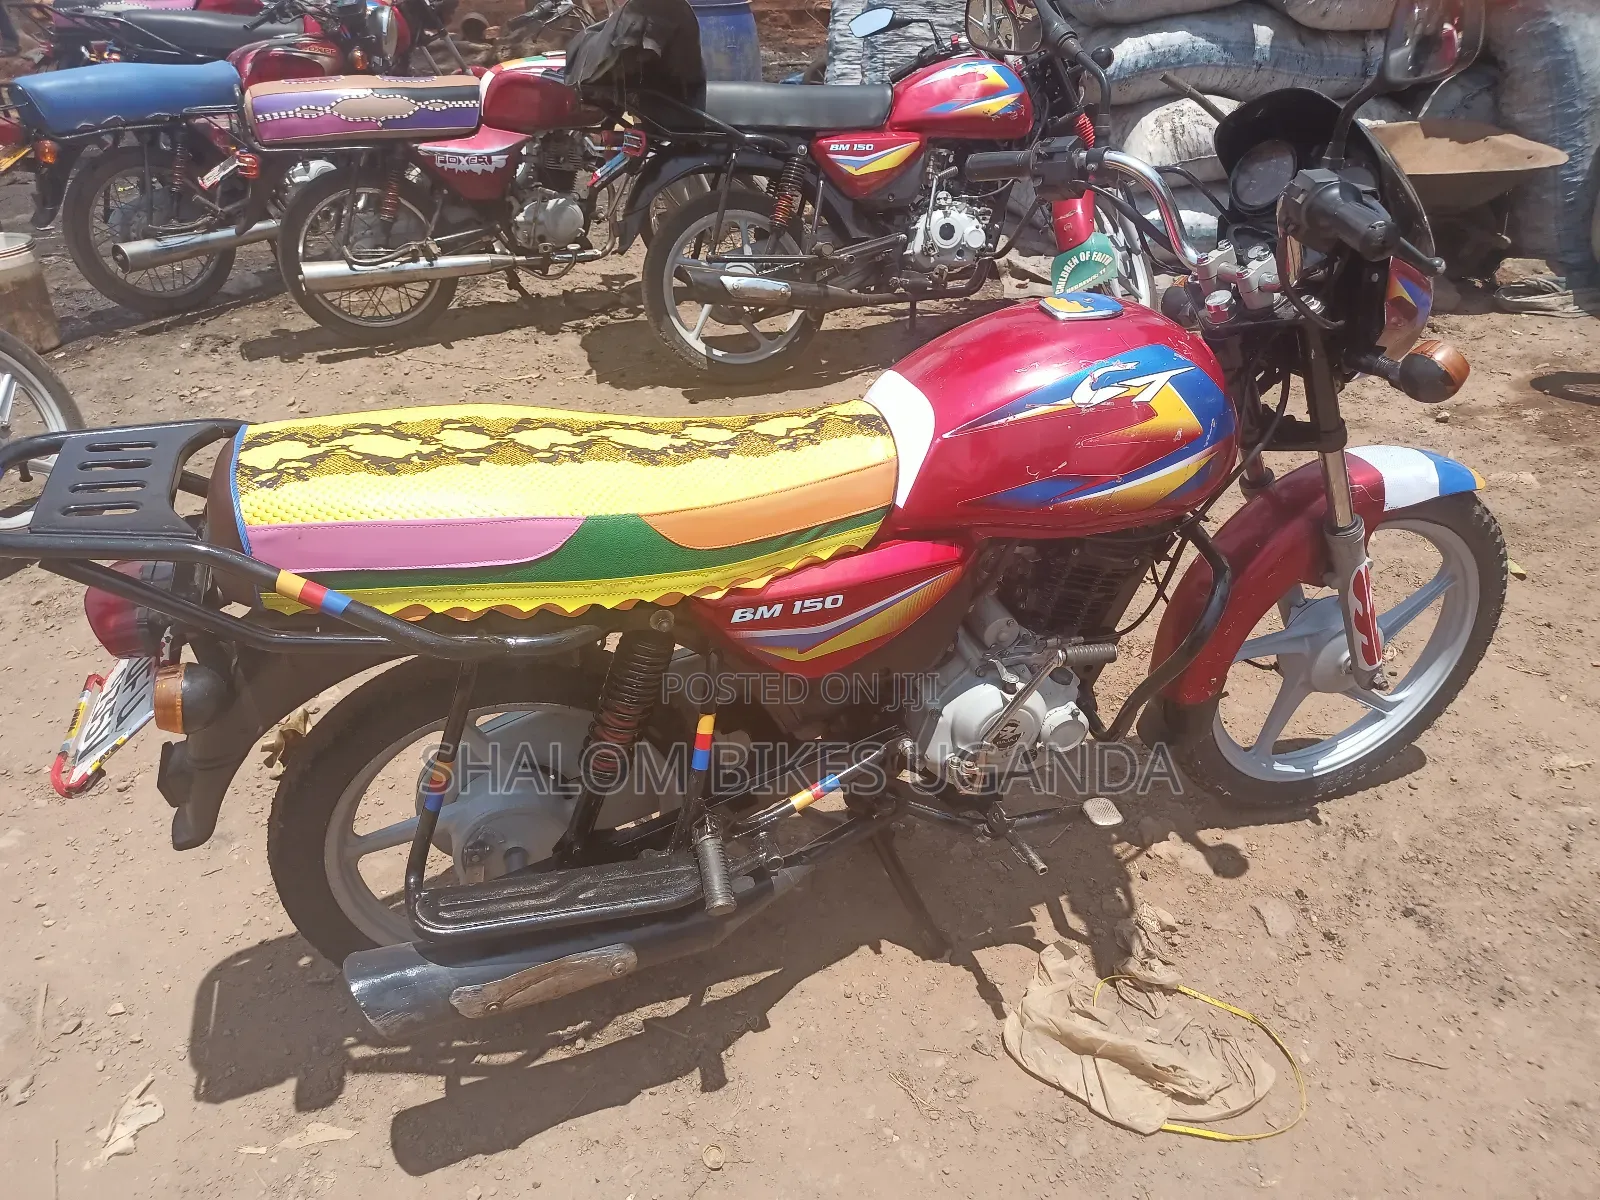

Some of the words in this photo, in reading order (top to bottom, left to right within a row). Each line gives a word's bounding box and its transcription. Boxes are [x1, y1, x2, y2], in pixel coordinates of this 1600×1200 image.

[829, 143, 851, 151] BM
[853, 143, 875, 151] 150
[1055, 255, 1080, 295] CHILDREN
[1079, 250, 1091, 262] OF
[730, 603, 784, 623] BM
[791, 594, 844, 615] 150
